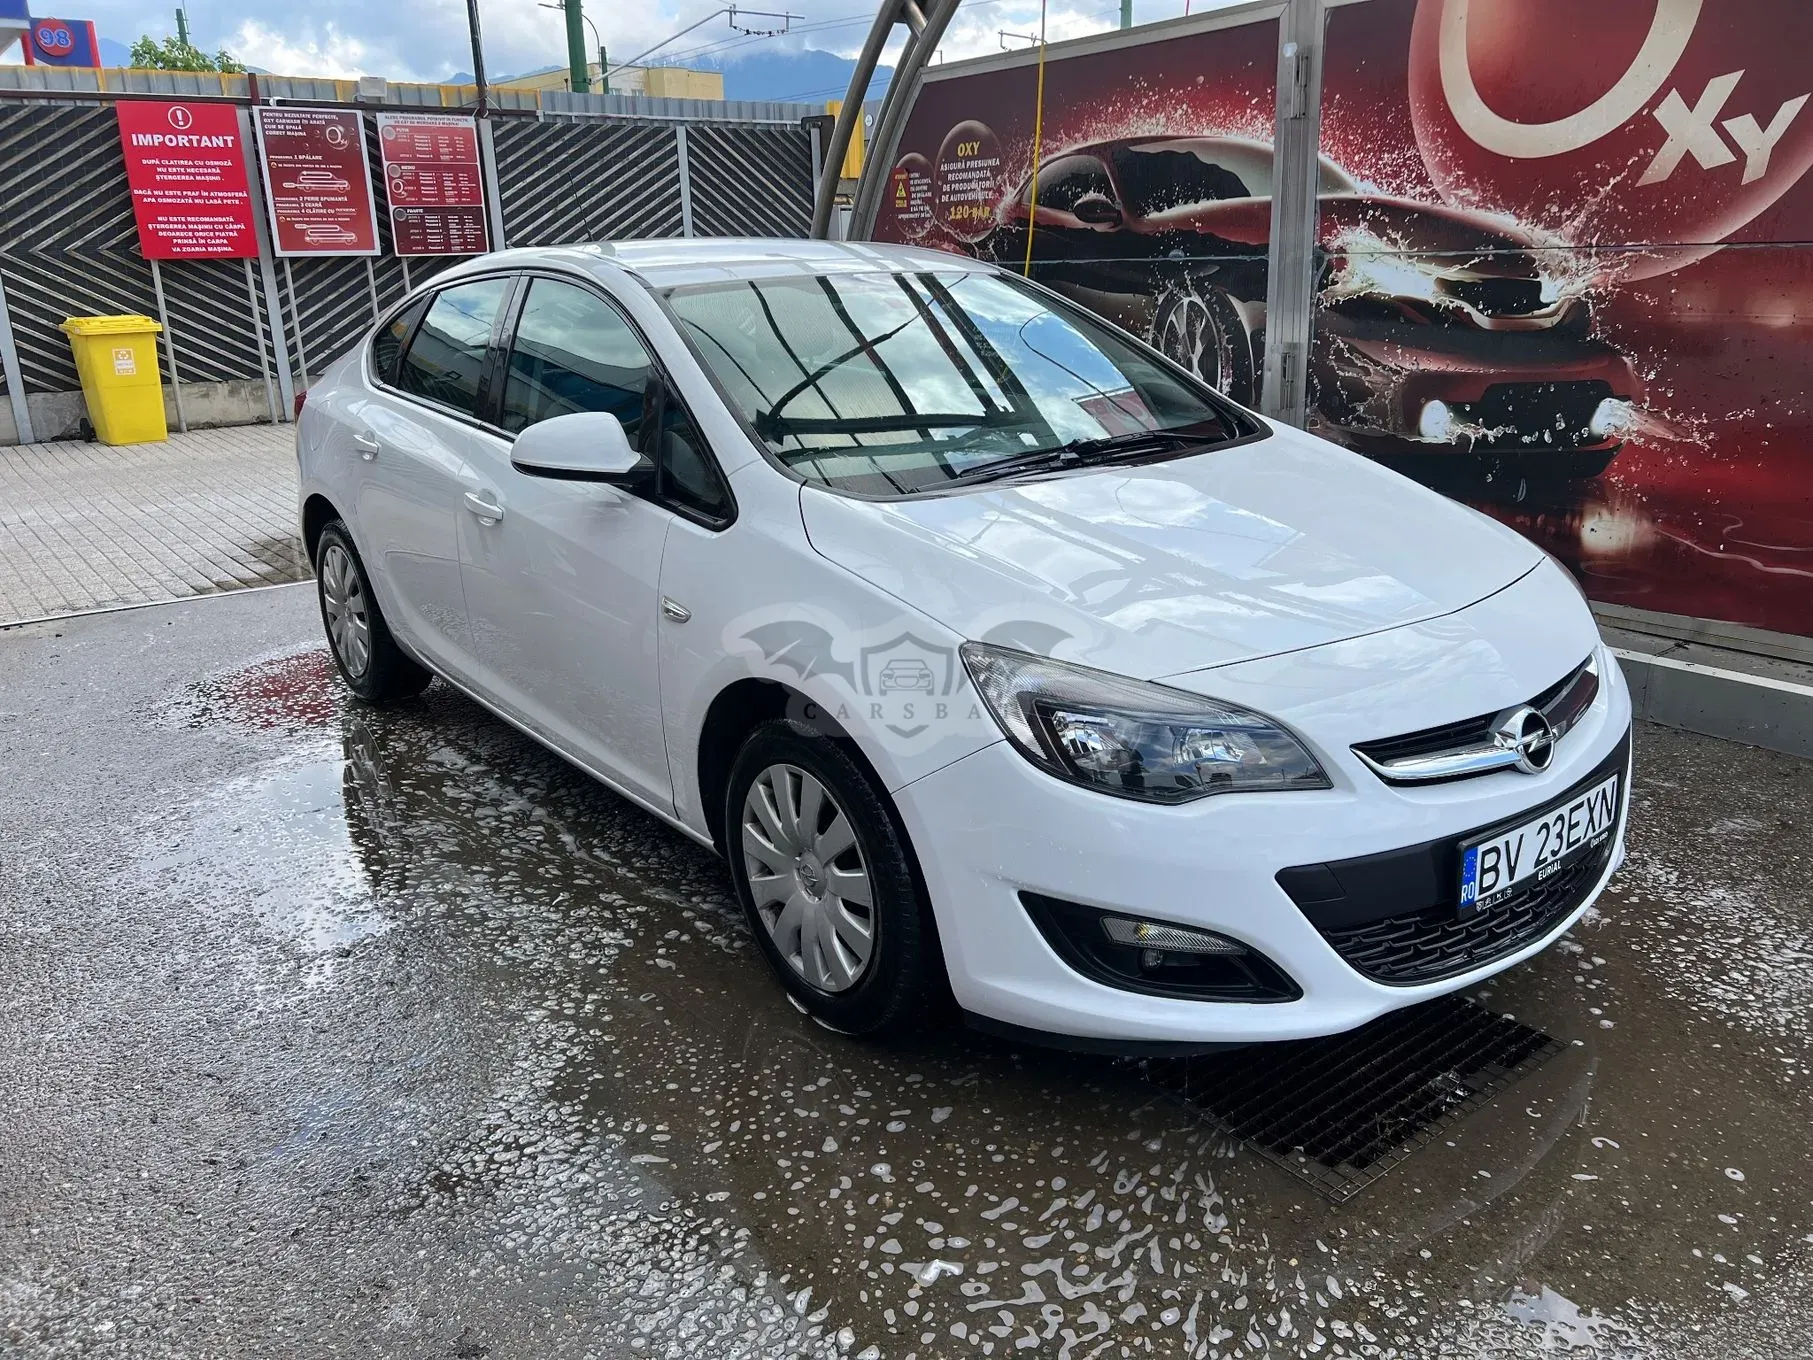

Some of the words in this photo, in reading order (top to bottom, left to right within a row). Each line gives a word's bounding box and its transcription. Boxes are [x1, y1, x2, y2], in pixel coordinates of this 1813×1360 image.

[39, 28, 71, 48] 98
[131, 134, 235, 148] IMPORTANT
[957, 142, 980, 157] OXY
[940, 159, 965, 171] ASIGURĂ
[966, 158, 1000, 169] PRESIUNEA
[948, 168, 991, 181] RECOMANDATĂ
[943, 184, 950, 192] DE
[1477, 832, 1525, 898] BV
[1533, 781, 1616, 870] 23EXN
[1538, 860, 1562, 881] EURIAL
[1460, 881, 1475, 904] RO
